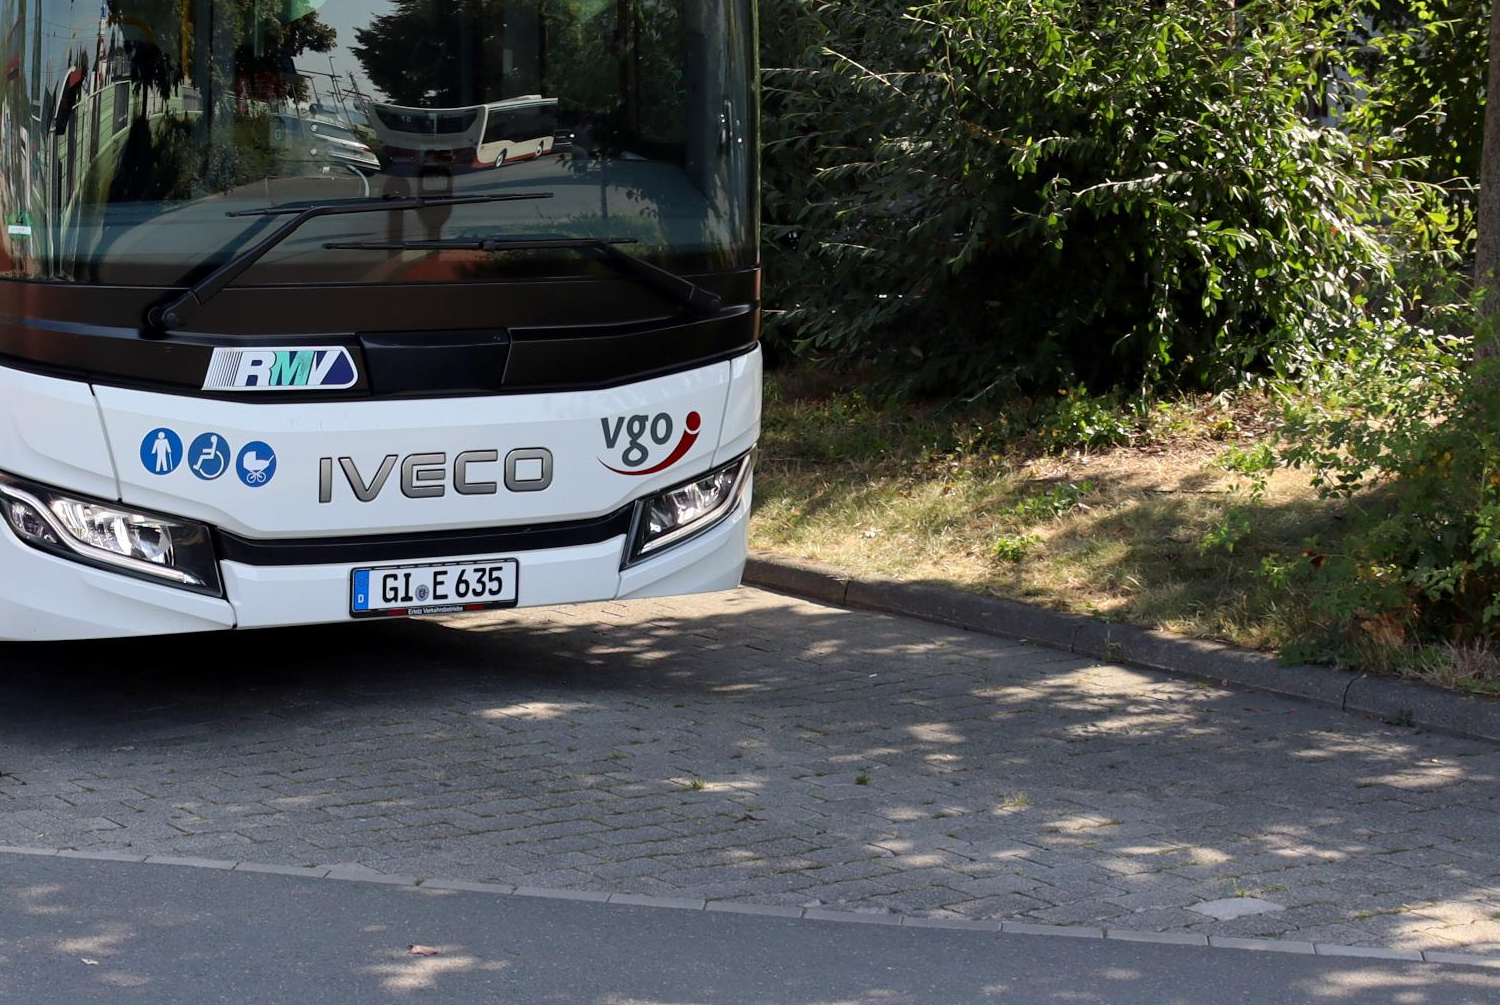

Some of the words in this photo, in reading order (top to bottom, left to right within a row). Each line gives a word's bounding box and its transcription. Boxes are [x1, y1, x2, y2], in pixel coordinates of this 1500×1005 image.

[232, 350, 342, 387] RMV
[601, 412, 674, 467] vgo
[318, 447, 554, 503] IVECO
[358, 594, 364, 603] D
[382, 573, 413, 603] GI
[433, 571, 448, 600] E
[456, 567, 503, 597] 635
